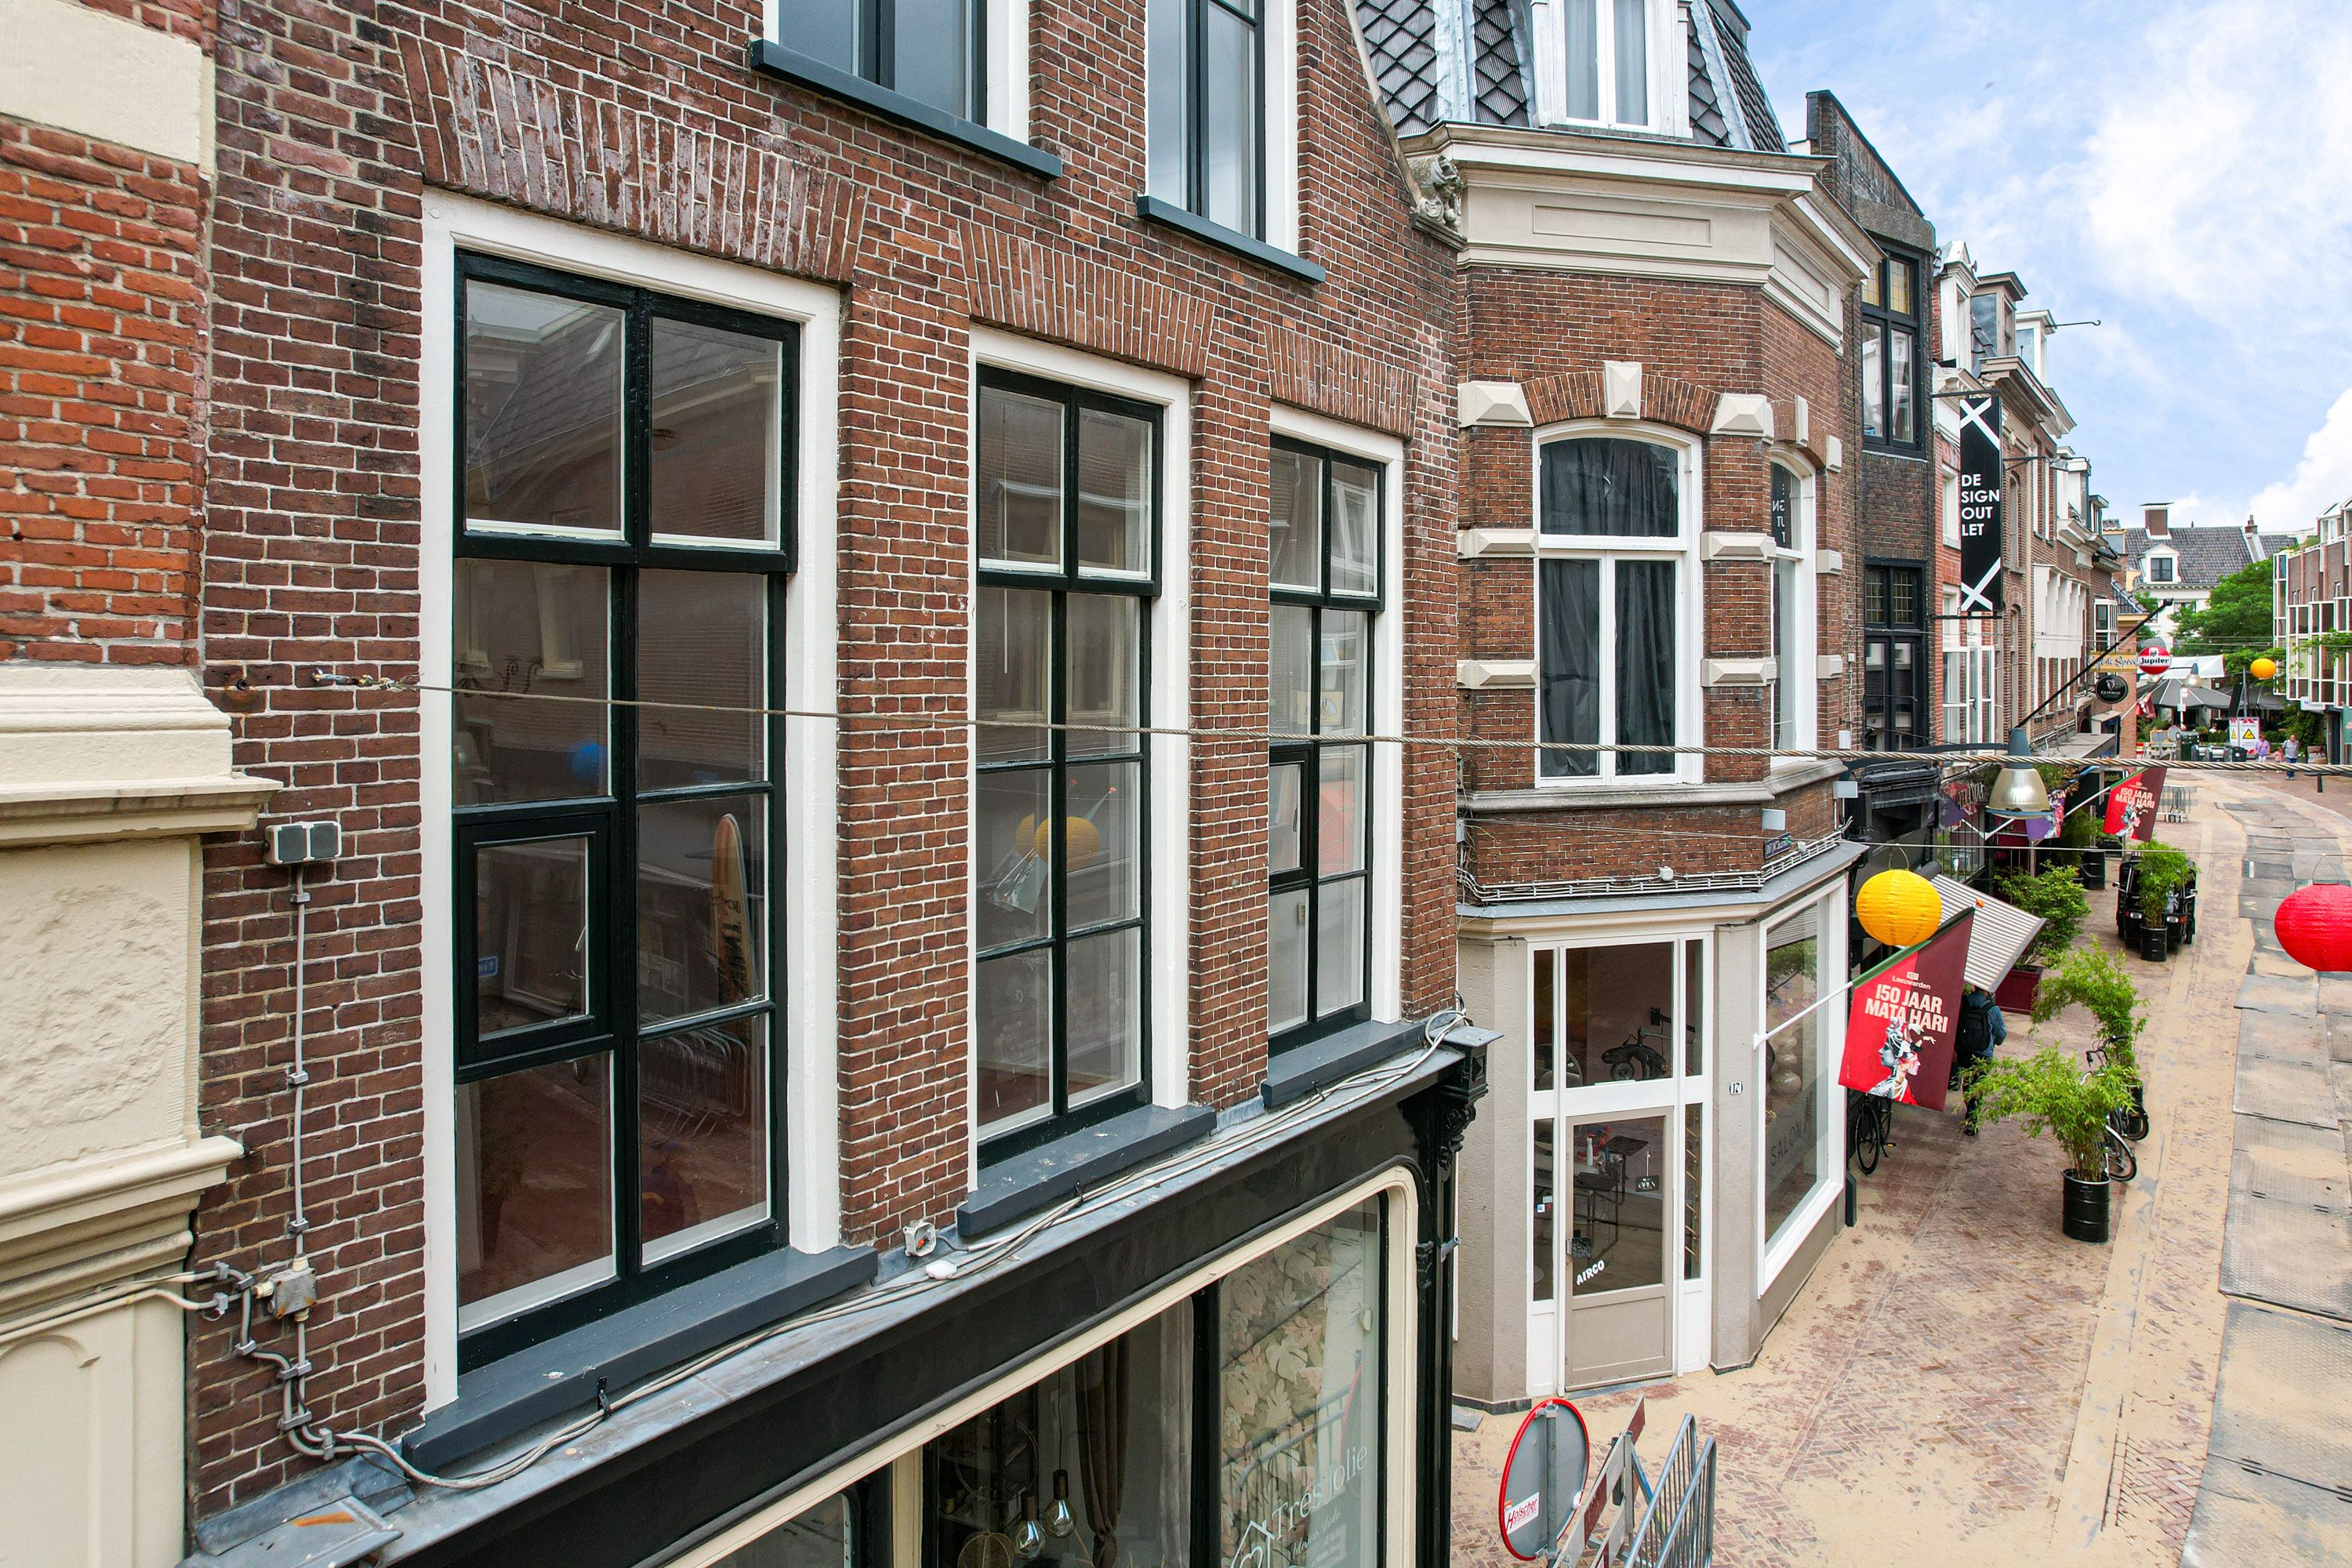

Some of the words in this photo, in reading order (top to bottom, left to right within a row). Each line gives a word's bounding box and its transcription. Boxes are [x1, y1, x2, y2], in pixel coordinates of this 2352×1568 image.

[1961, 474, 1982, 487] DE
[1961, 489, 2000, 503] SIGN
[1961, 506, 1993, 520] OUT
[1962, 523, 1984, 536] LET
[2114, 793, 2136, 805] MATA
[2136, 797, 2155, 809] HARI
[2133, 789, 2154, 800] JAAR
[1892, 975, 1931, 990] Leeuwarden
[1875, 983, 1901, 1004] 150
[1901, 989, 1943, 1014] JAAR
[1864, 997, 1907, 1023] MATA
[1909, 1008, 1948, 1033] HARI
[1770, 1120, 1802, 1167] SALON
[1576, 1259, 1605, 1286] AIRCO
